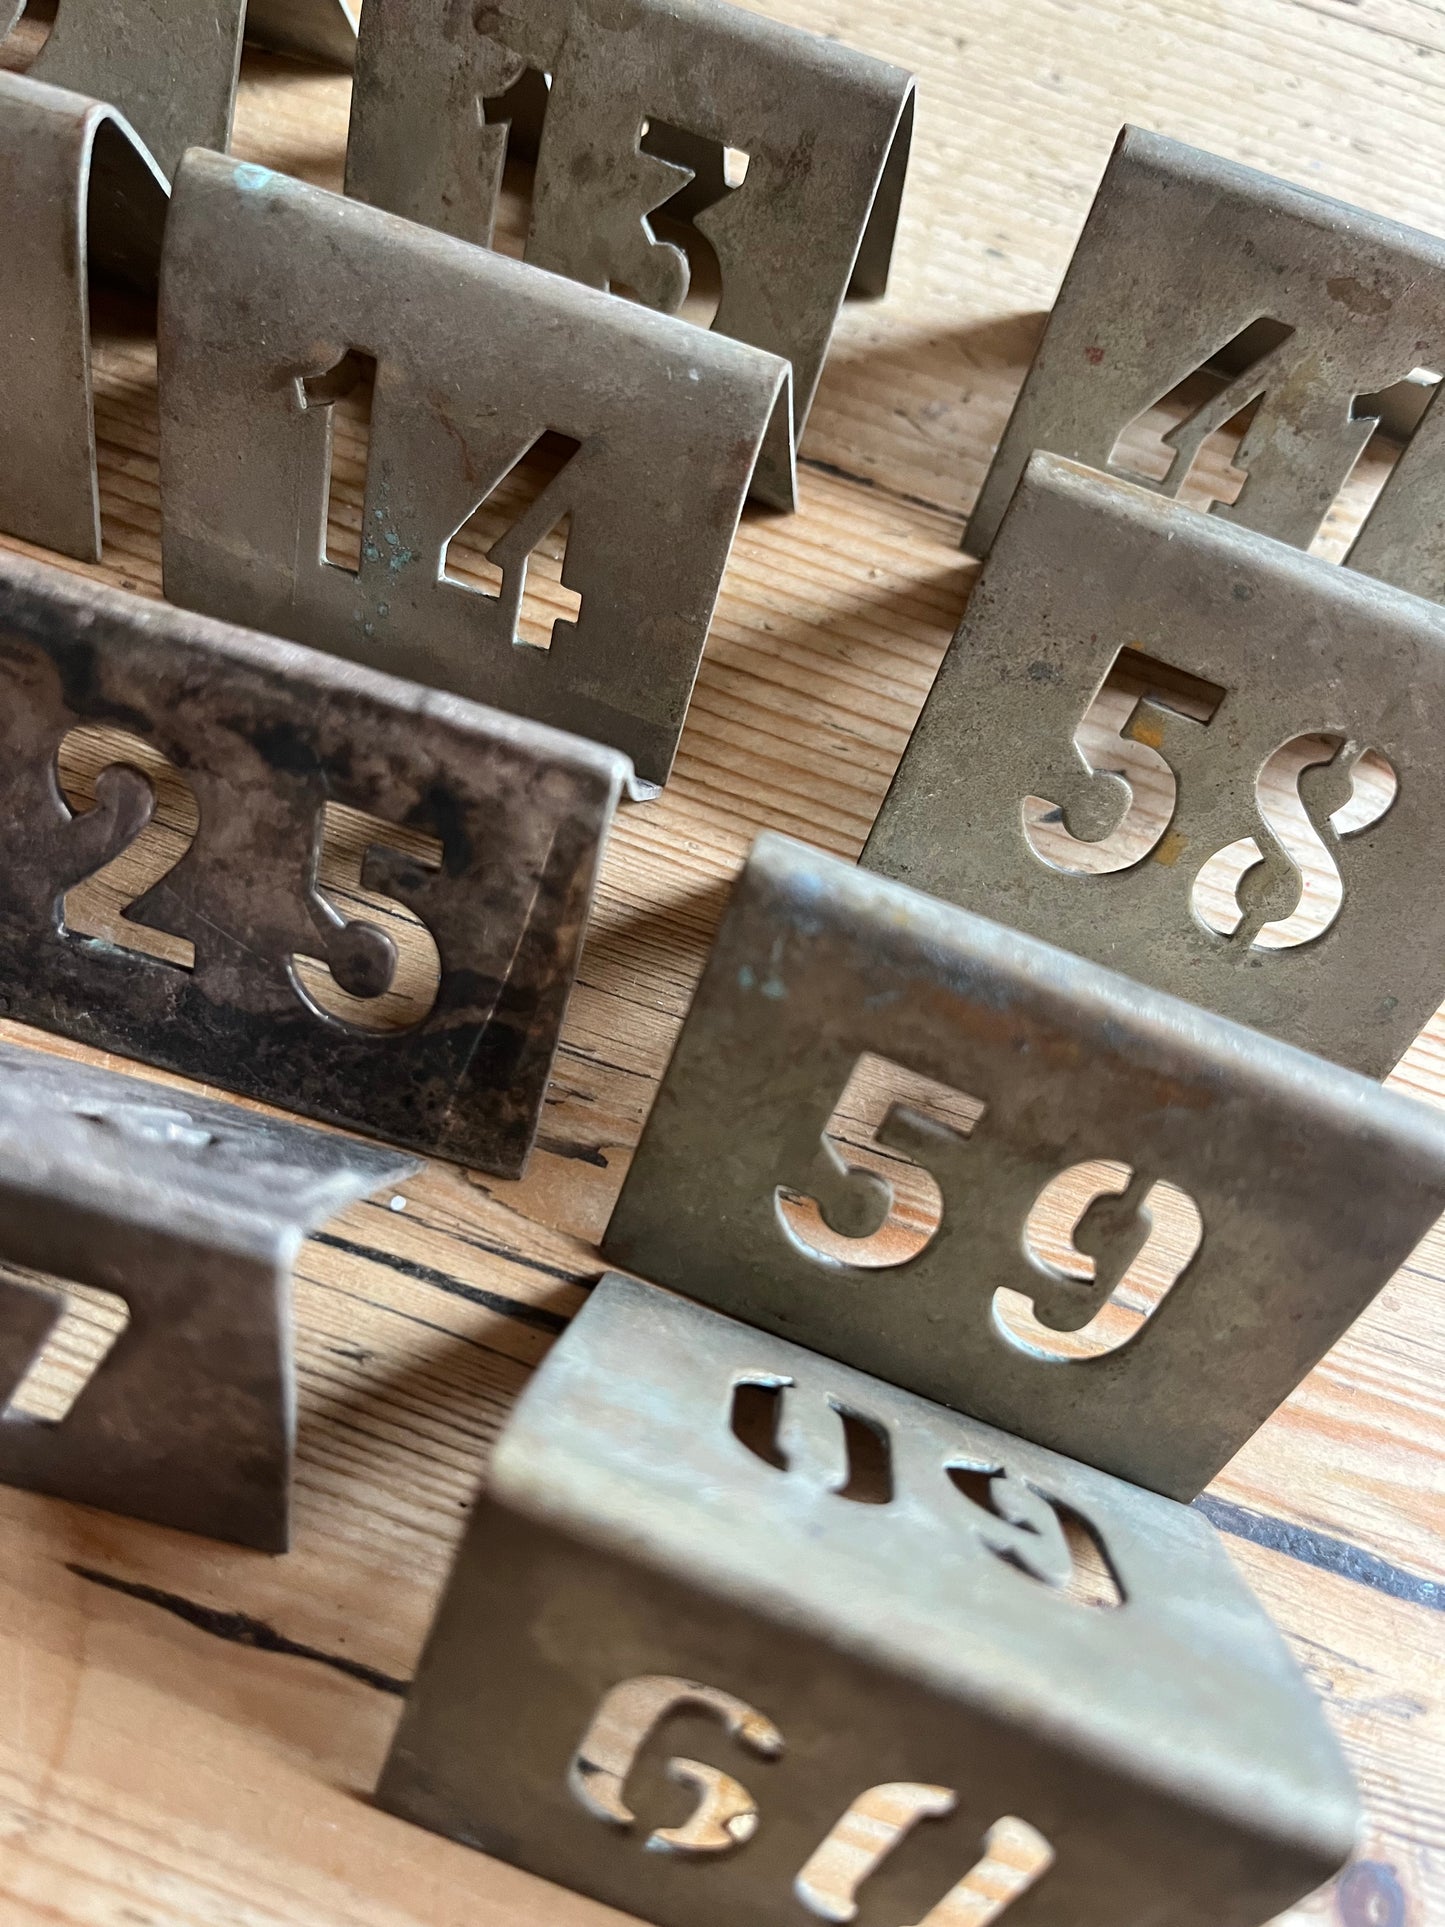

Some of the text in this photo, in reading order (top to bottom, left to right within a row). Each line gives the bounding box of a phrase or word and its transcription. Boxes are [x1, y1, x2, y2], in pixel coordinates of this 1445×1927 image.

[476, 66, 750, 331] 13
[293, 347, 584, 651] 14
[1106, 316, 1445, 567] 41
[53, 724, 446, 1037] 25
[1021, 643, 1399, 952] 58
[774, 1051, 1203, 1361] 59
[567, 1674, 1057, 1927] 60
